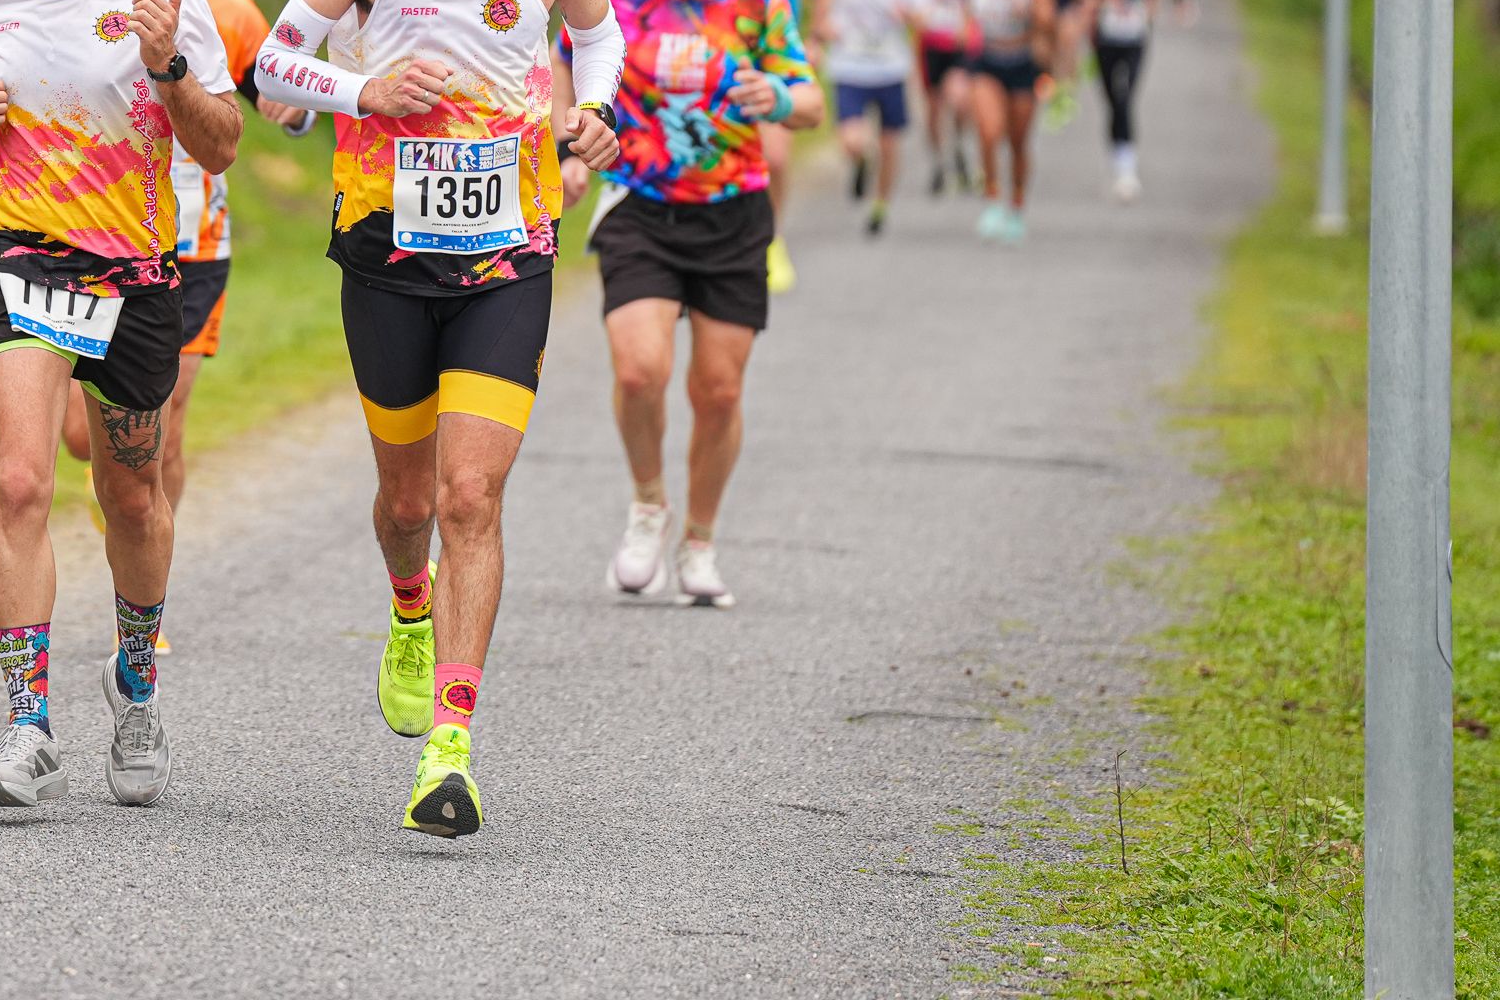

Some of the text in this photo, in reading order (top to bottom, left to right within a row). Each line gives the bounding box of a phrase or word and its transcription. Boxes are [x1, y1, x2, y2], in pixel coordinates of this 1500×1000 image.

[401, 7, 439, 16] FASTER
[282, 62, 338, 96] ASTIGI
[132, 77, 162, 283] Club Atletismo Astigi
[414, 174, 502, 219] 1350
[11, 637, 28, 651] MI
[124, 639, 148, 652] THE
[0, 653, 30, 670] EROE!
[7, 676, 25, 697] HE
